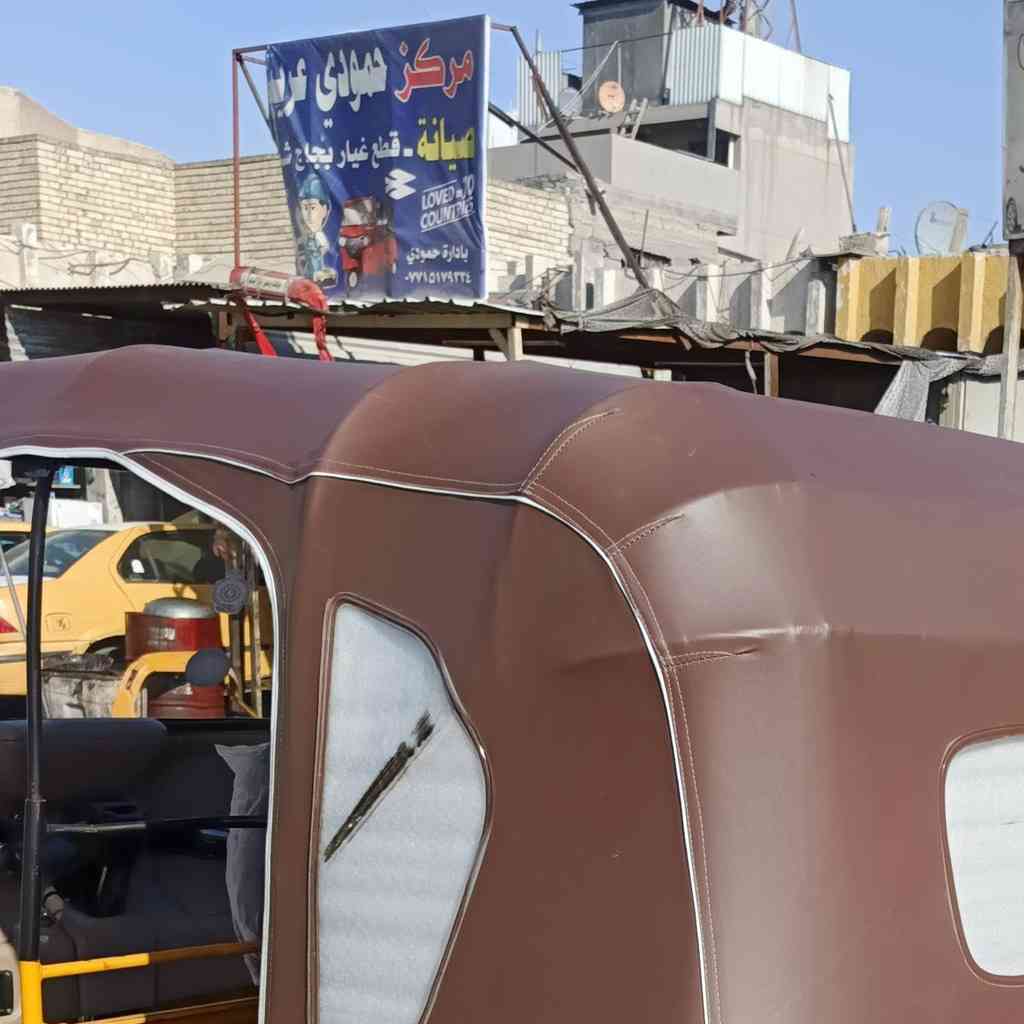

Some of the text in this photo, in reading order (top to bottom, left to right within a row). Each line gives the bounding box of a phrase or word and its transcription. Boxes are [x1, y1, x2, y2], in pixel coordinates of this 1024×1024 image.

[316, 46, 387, 127] حمودي
[394, 38, 474, 103] مركز
[336, 137, 368, 169] غيار
[372, 130, 400, 168] قطع
[416, 117, 475, 172] صيانة
[421, 185, 455, 210] LOVED
